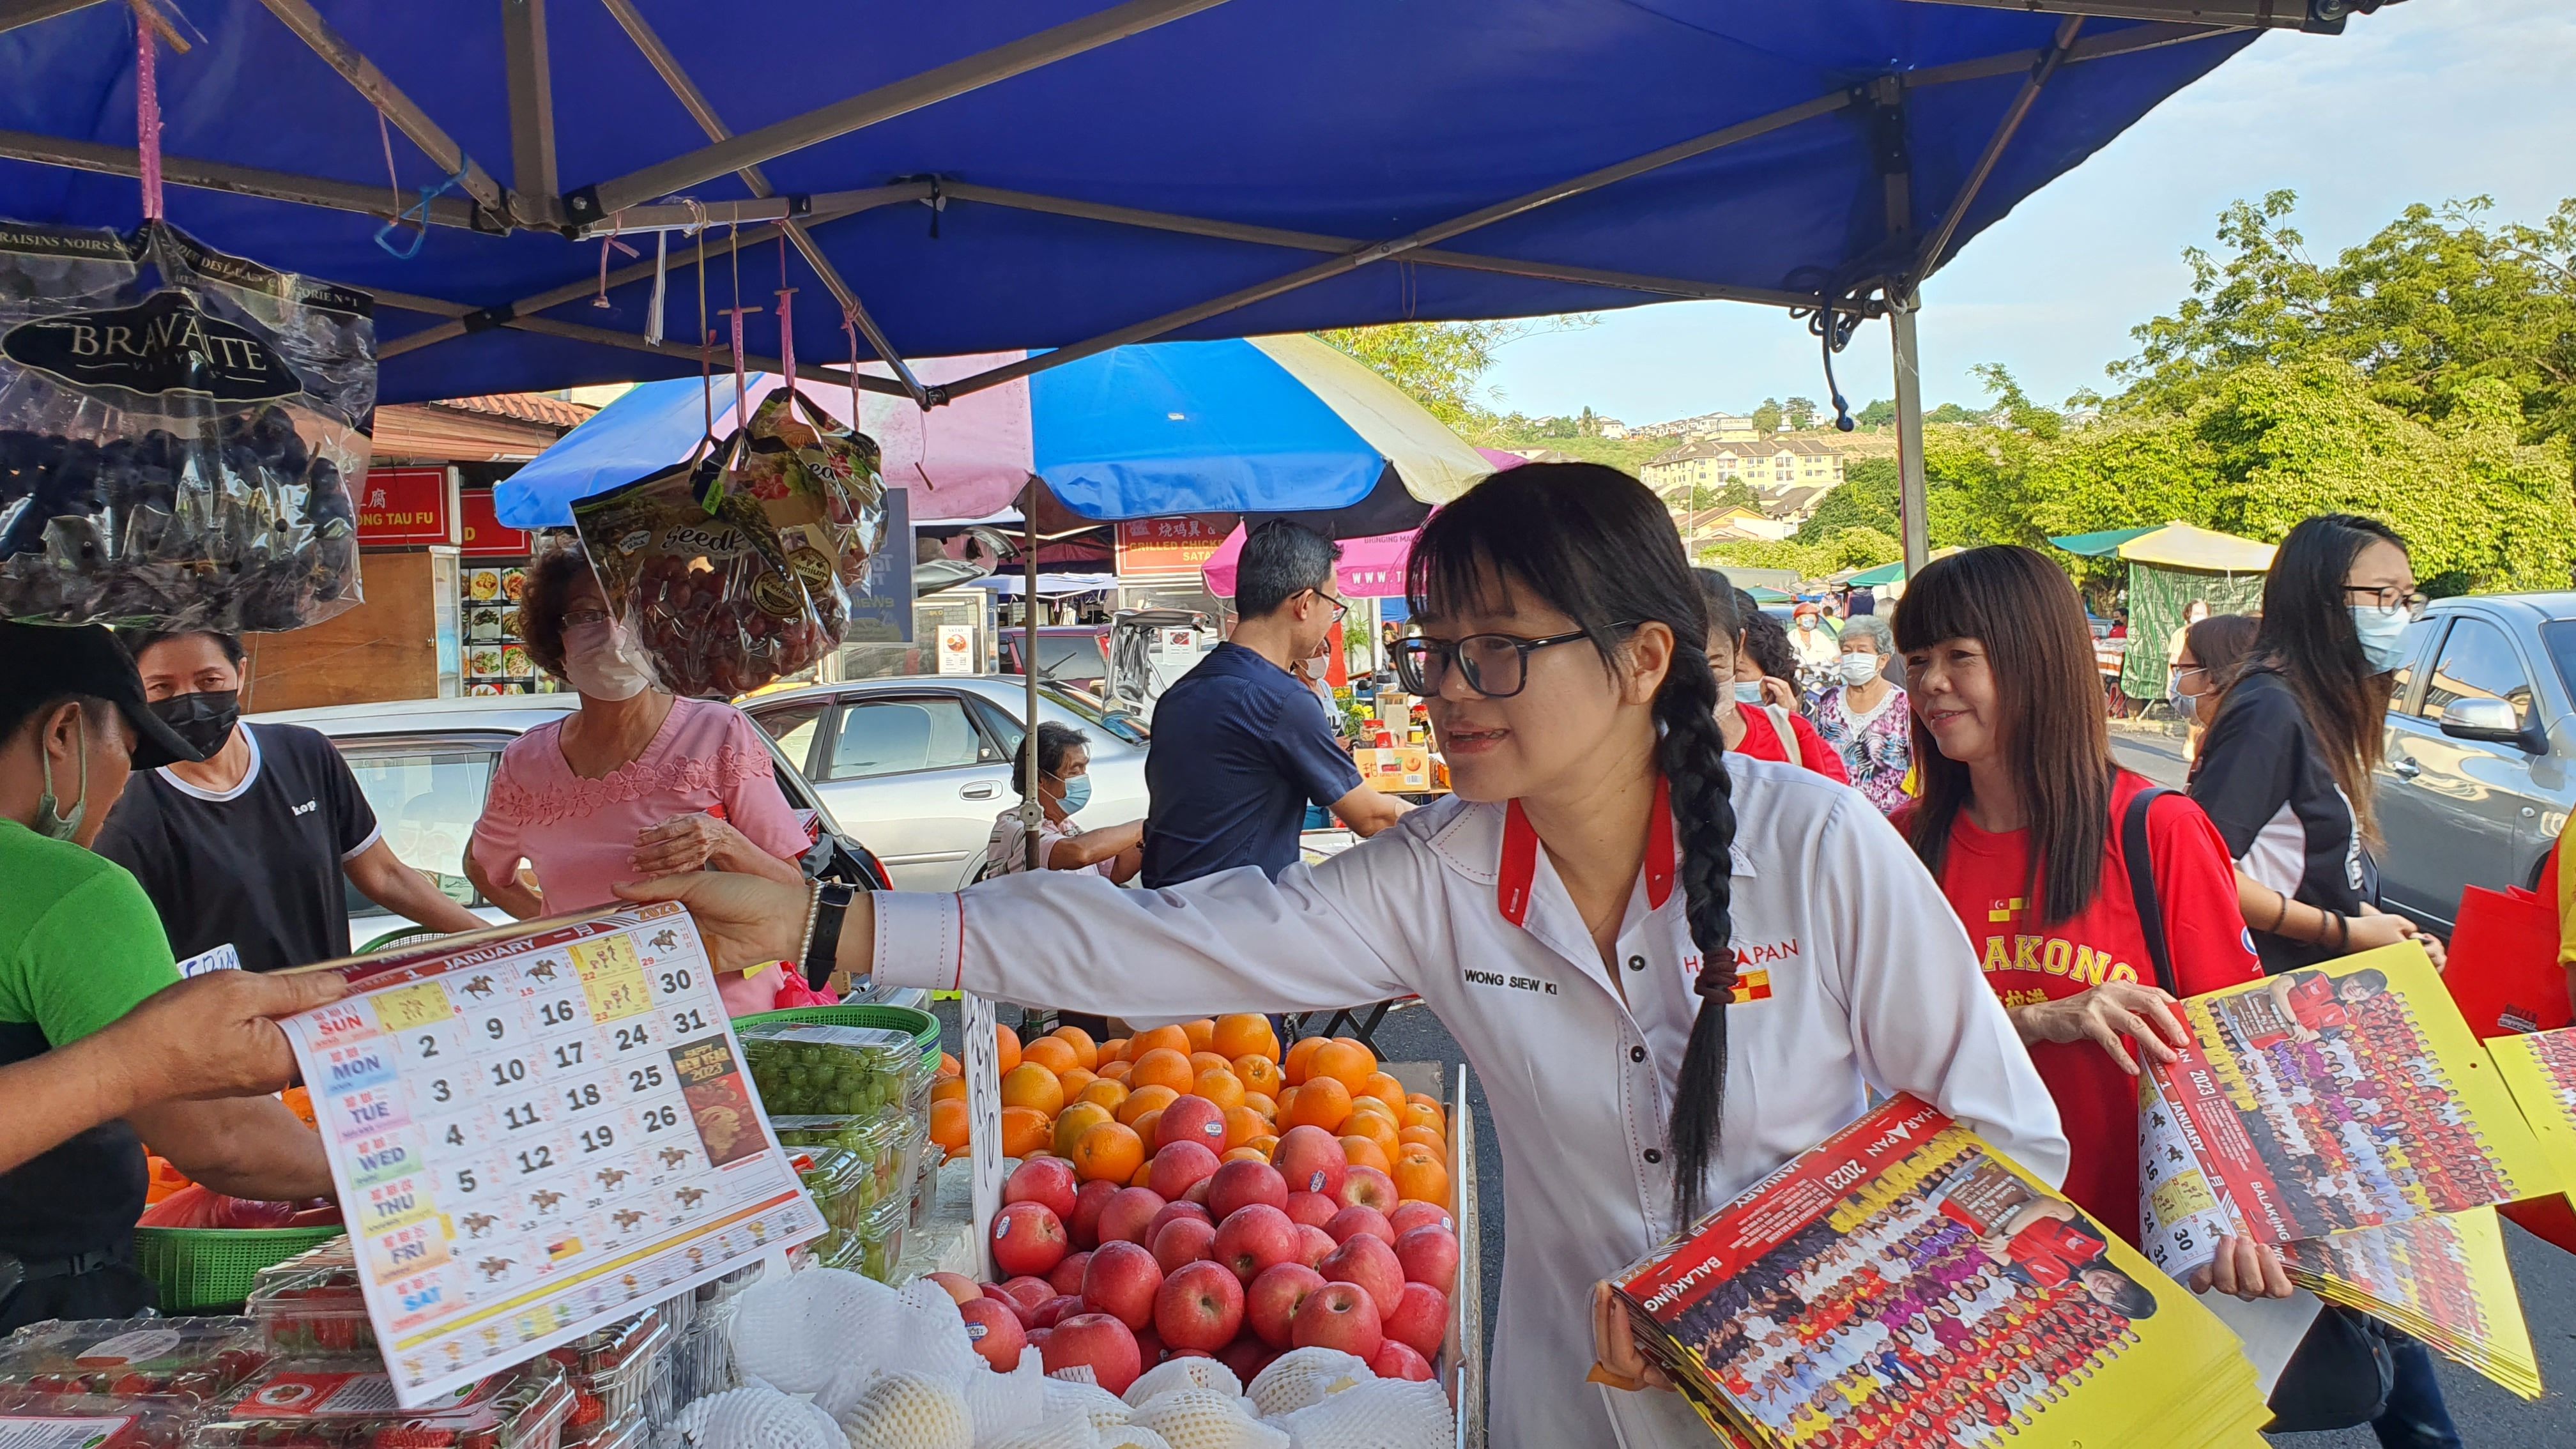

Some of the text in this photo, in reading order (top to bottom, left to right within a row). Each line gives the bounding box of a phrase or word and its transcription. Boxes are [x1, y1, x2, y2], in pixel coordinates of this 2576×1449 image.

[0, 232, 59, 247] RAISINS
[64, 238, 110, 251] NOIRS
[386, 512, 412, 525] TAU
[416, 511, 433, 524] FU
[1129, 541, 1178, 552] GRILLED
[1183, 551, 1215, 562] SATA
[291, 797, 317, 816] kop
[634, 901, 680, 921] 2023
[553, 923, 596, 939] 一月
[443, 938, 536, 971] JANUARY
[641, 956, 656, 967] 29
[1683, 939, 1799, 974] HAPAN
[660, 969, 691, 994] 30
[1464, 969, 1558, 995] WONG SIEW KI
[319, 1015, 364, 1036] SUN
[540, 1000, 574, 1027] 16
[673, 1008, 707, 1034] 31
[487, 1018, 504, 1040] 9
[615, 1023, 649, 1052] 24
[419, 1035, 440, 1058] 2
[555, 1041, 583, 1068] 17
[331, 1055, 381, 1080] MON
[491, 1059, 525, 1086] 10
[629, 1064, 663, 1092] 25
[689, 1062, 724, 1082] 2023
[433, 1079, 451, 1102] 3
[2189, 1069, 2216, 1096] 2023
[567, 1084, 601, 1112] 18
[349, 1101, 390, 1124] TUE
[504, 1102, 542, 1130] 11
[643, 1105, 677, 1133] 26
[2159, 1080, 2172, 1092] 1
[2168, 1100, 2207, 1152] JANUARY
[446, 1124, 465, 1146] 4
[580, 1125, 614, 1153] 19
[1864, 1107, 1938, 1157] HARAPAN
[357, 1147, 406, 1171] WED
[518, 1145, 553, 1174] 12
[2145, 1159, 2159, 1181] 16
[457, 1169, 476, 1193] 5
[1734, 1160, 1803, 1209] JANUARY
[1824, 1159, 1867, 1190] 2023
[2171, 1177, 2179, 1187] 22
[2206, 1162, 2225, 1188] 一月
[1689, 1215, 1722, 1238] 一月
[2143, 1211, 2155, 1234] 24
[2189, 1214, 2199, 1223] 29
[2174, 1228, 2194, 1251] 30
[2153, 1244, 2169, 1269] 31
